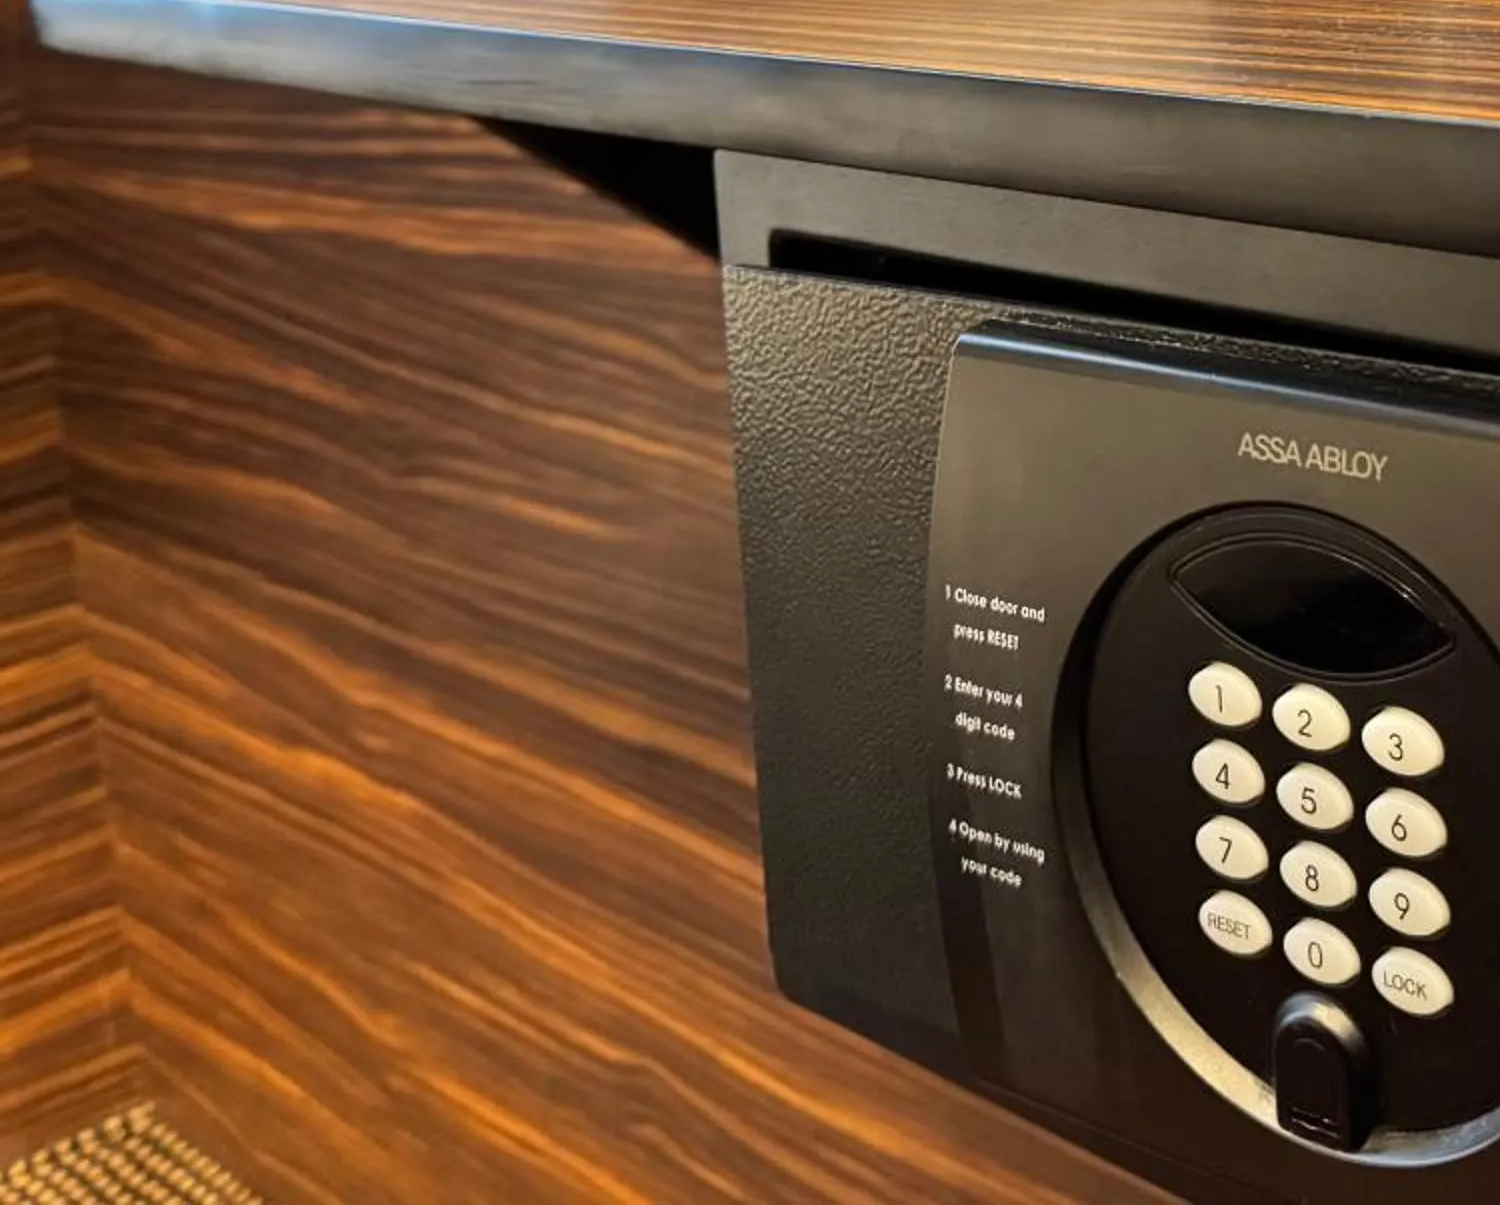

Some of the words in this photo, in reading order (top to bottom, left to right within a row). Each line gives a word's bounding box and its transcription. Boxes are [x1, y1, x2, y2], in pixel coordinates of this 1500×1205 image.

[1237, 431, 1303, 468] ASSA
[1304, 443, 1389, 482] ABLOY
[954, 588, 987, 608] Close
[990, 596, 1018, 615] door
[1021, 606, 1045, 623] and
[954, 624, 985, 643] press
[987, 628, 1019, 650] RESET
[944, 674, 953, 691] 2
[955, 676, 984, 699] Enter
[986, 688, 1013, 706] your
[1015, 693, 1023, 709] 4
[1216, 684, 1223, 713] 1
[955, 712, 982, 733] digit
[984, 721, 1016, 741] code
[1297, 708, 1313, 738] 2
[1388, 732, 1404, 762] 3
[947, 763, 955, 779] 3
[957, 766, 987, 789] Press
[989, 776, 1022, 799] LOCK
[1215, 762, 1231, 790] 4
[1301, 787, 1317, 815] 5
[949, 818, 957, 834] 4
[959, 821, 993, 844] Open
[994, 832, 1010, 853] by
[1013, 841, 1045, 866] using
[1391, 814, 1408, 843] 6
[1218, 836, 1233, 864] 7
[961, 856, 987, 875] your
[989, 866, 1022, 889] code
[1304, 864, 1320, 893] 8
[1394, 892, 1410, 920] 9
[1207, 912, 1250, 941] RESET
[1307, 941, 1324, 969] 0
[1383, 973, 1427, 999] LOCK
